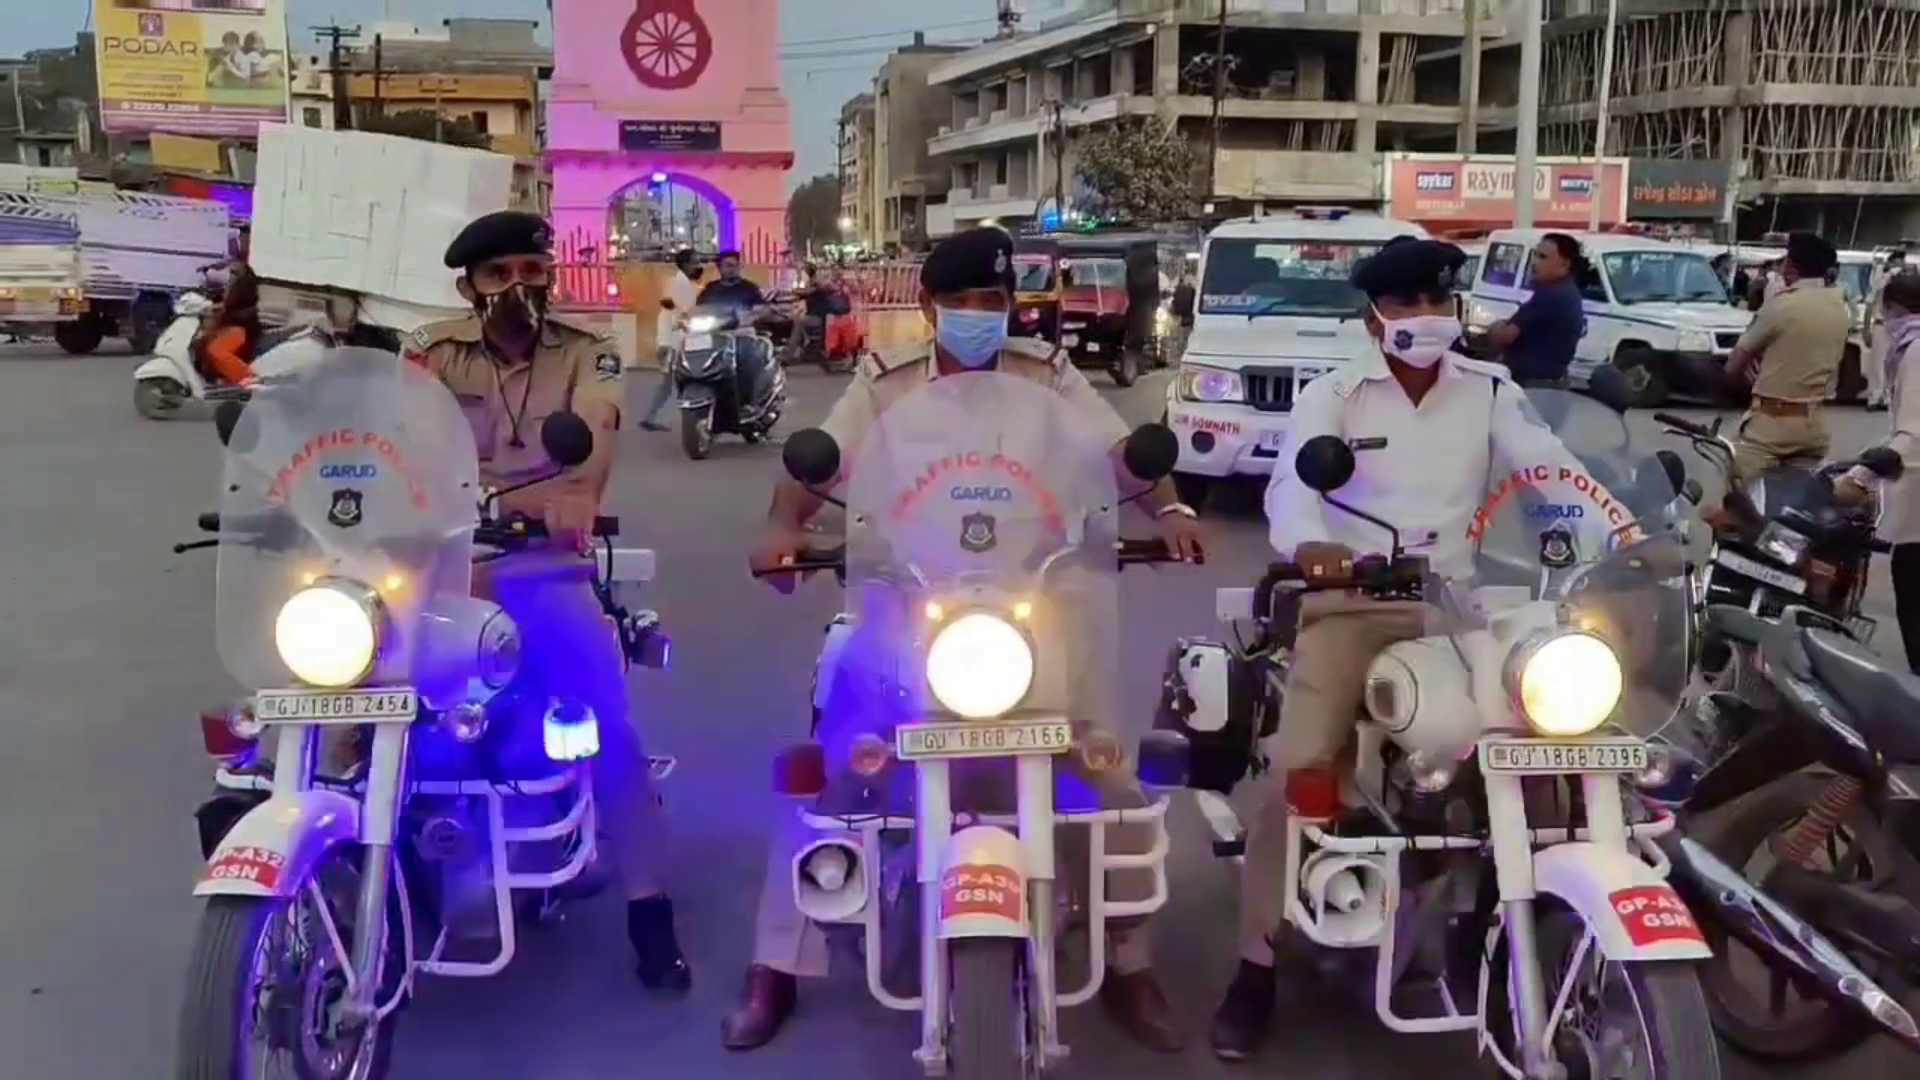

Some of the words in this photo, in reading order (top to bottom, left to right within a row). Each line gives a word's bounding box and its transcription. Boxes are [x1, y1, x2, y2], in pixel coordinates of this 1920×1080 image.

[103, 37, 198, 56] PODAR
[1191, 416, 1241, 435] SOMNATH
[268, 428, 354, 503] TRAFFIC
[363, 431, 430, 511] POL
[319, 463, 377, 479] GARUD
[950, 485, 1012, 502] GARUD
[991, 453, 1065, 533] POL
[1465, 464, 1549, 541] TRAFFIC
[1559, 467, 1634, 544] POLICE
[1523, 504, 1584, 519] GARUD
[278, 699, 300, 716] GJ
[311, 697, 354, 715] 18GB
[362, 694, 409, 713] 2454
[1015, 726, 1066, 746] 2166
[1510, 748, 1532, 767] GJ
[1543, 748, 1588, 767] 18GB
[1597, 748, 1643, 767] 2396
[211, 864, 260, 880] GSN
[955, 888, 1005, 905] GSN
[1642, 912, 1694, 930] GSN
